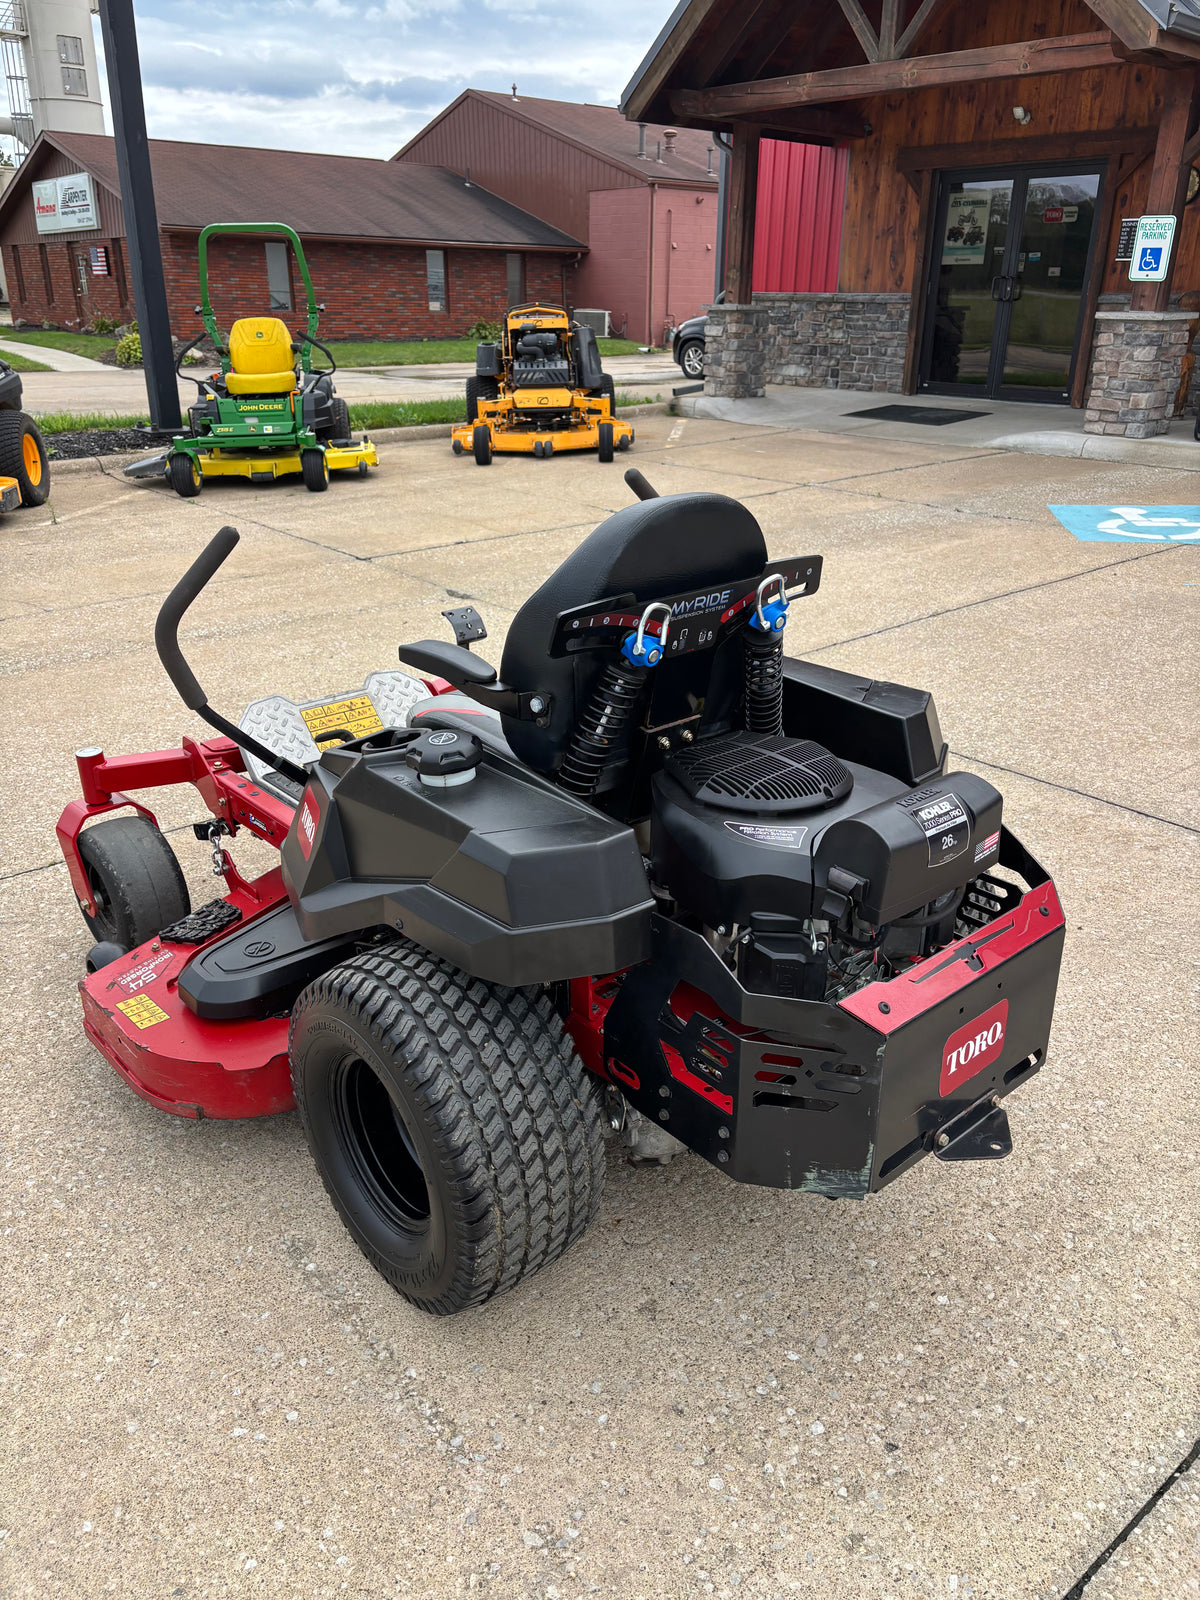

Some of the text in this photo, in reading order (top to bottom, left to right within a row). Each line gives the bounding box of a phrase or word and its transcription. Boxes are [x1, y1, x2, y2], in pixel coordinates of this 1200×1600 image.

[1140, 222, 1172, 231] RESERVED
[1141, 232, 1168, 240] PARKING
[669, 610, 704, 622] SUSPENSION
[705, 604, 726, 613] SYSTEM
[896, 788, 943, 808] KOHLER
[918, 801, 955, 820] KOHLER
[923, 809, 962, 830] 7000 Series PRO
[301, 802, 316, 843] TORO
[942, 834, 953, 850] 26
[120, 952, 173, 985] IRONFORGED
[946, 1021, 1002, 1076] TORO
